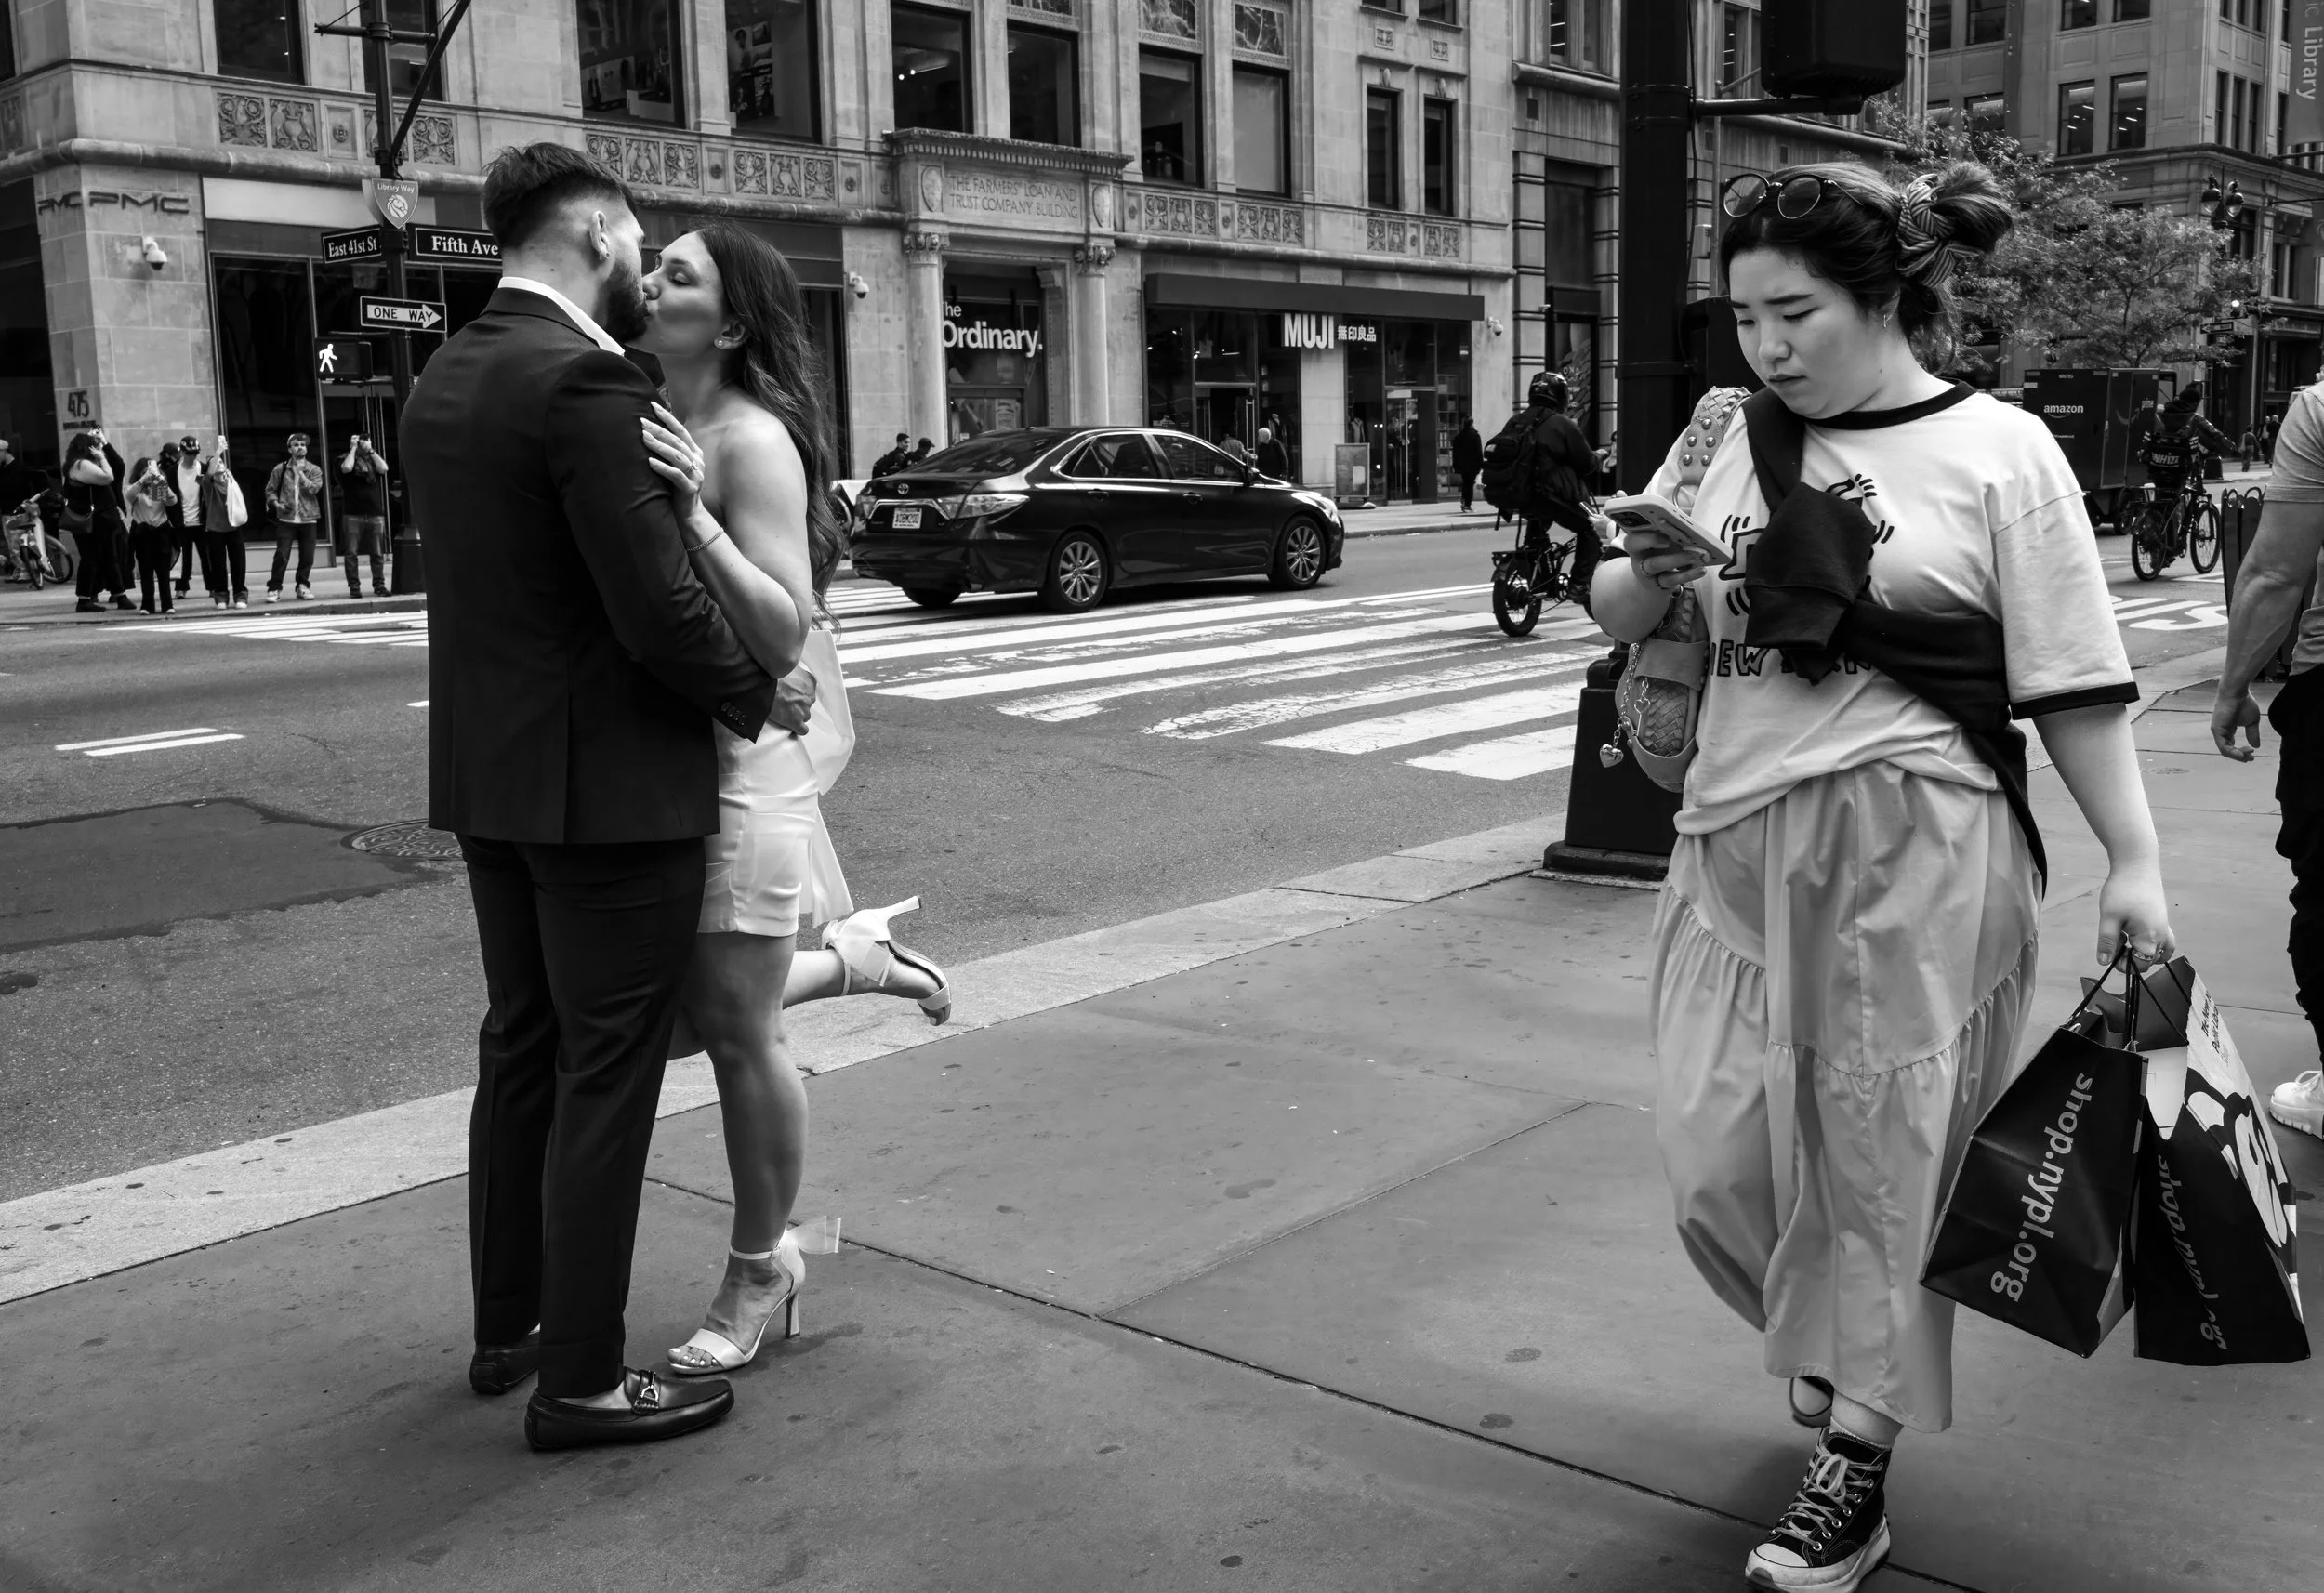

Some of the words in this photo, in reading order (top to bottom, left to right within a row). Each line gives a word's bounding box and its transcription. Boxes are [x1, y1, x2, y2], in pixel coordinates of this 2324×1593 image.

[2295, 26, 2324, 99] Library
[376, 182, 400, 192] Library
[400, 185, 416, 194] Way
[950, 175, 971, 191] THE
[1023, 183, 1053, 199] LOAN
[1054, 188, 1077, 202] AND
[89, 191, 190, 215] PMC
[949, 193, 979, 210] TRUST
[982, 196, 1035, 215] COMPANY
[1036, 202, 1079, 219] BUILDING
[328, 242, 348, 258] East
[348, 238, 367, 255] 41st
[367, 235, 378, 252] St
[431, 235, 469, 255] Fifth
[471, 239, 499, 257] Ave
[374, 306, 398, 320] ONE
[409, 309, 433, 323] WAY
[1284, 313, 1335, 349] MUJI
[1338, 323, 1377, 343] 無印良品
[67, 390, 90, 417] 475
[2043, 404, 2084, 414] amazon
[1710, 639, 1771, 678] EW
[1990, 1072, 2093, 1303] shop.nypl.org
